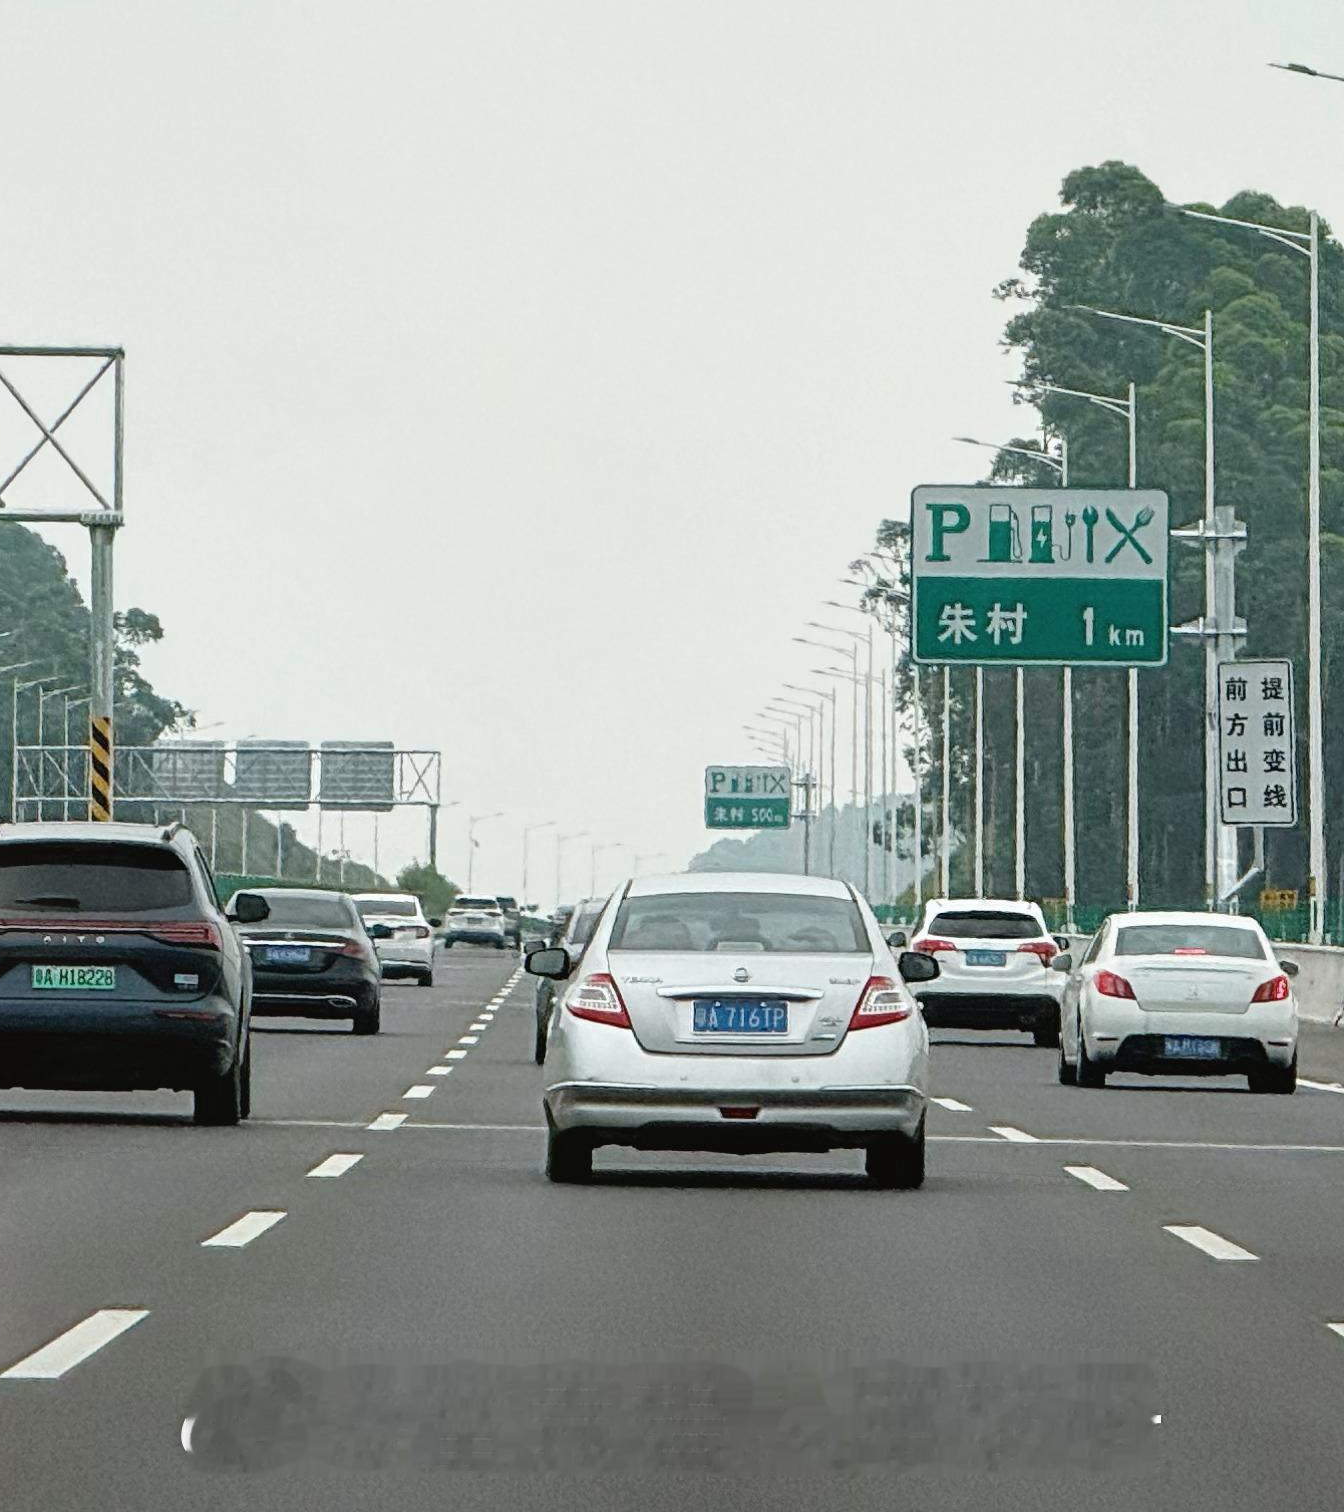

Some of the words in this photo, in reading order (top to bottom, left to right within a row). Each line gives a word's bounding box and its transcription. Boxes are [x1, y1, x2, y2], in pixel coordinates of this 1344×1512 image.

[937, 602, 1028, 646] 朱村
[1083, 607, 1094, 646] 1
[1108, 624, 1145, 646] km
[1225, 677, 1248, 808] 前方出口
[1261, 677, 1287, 808] 提前变线
